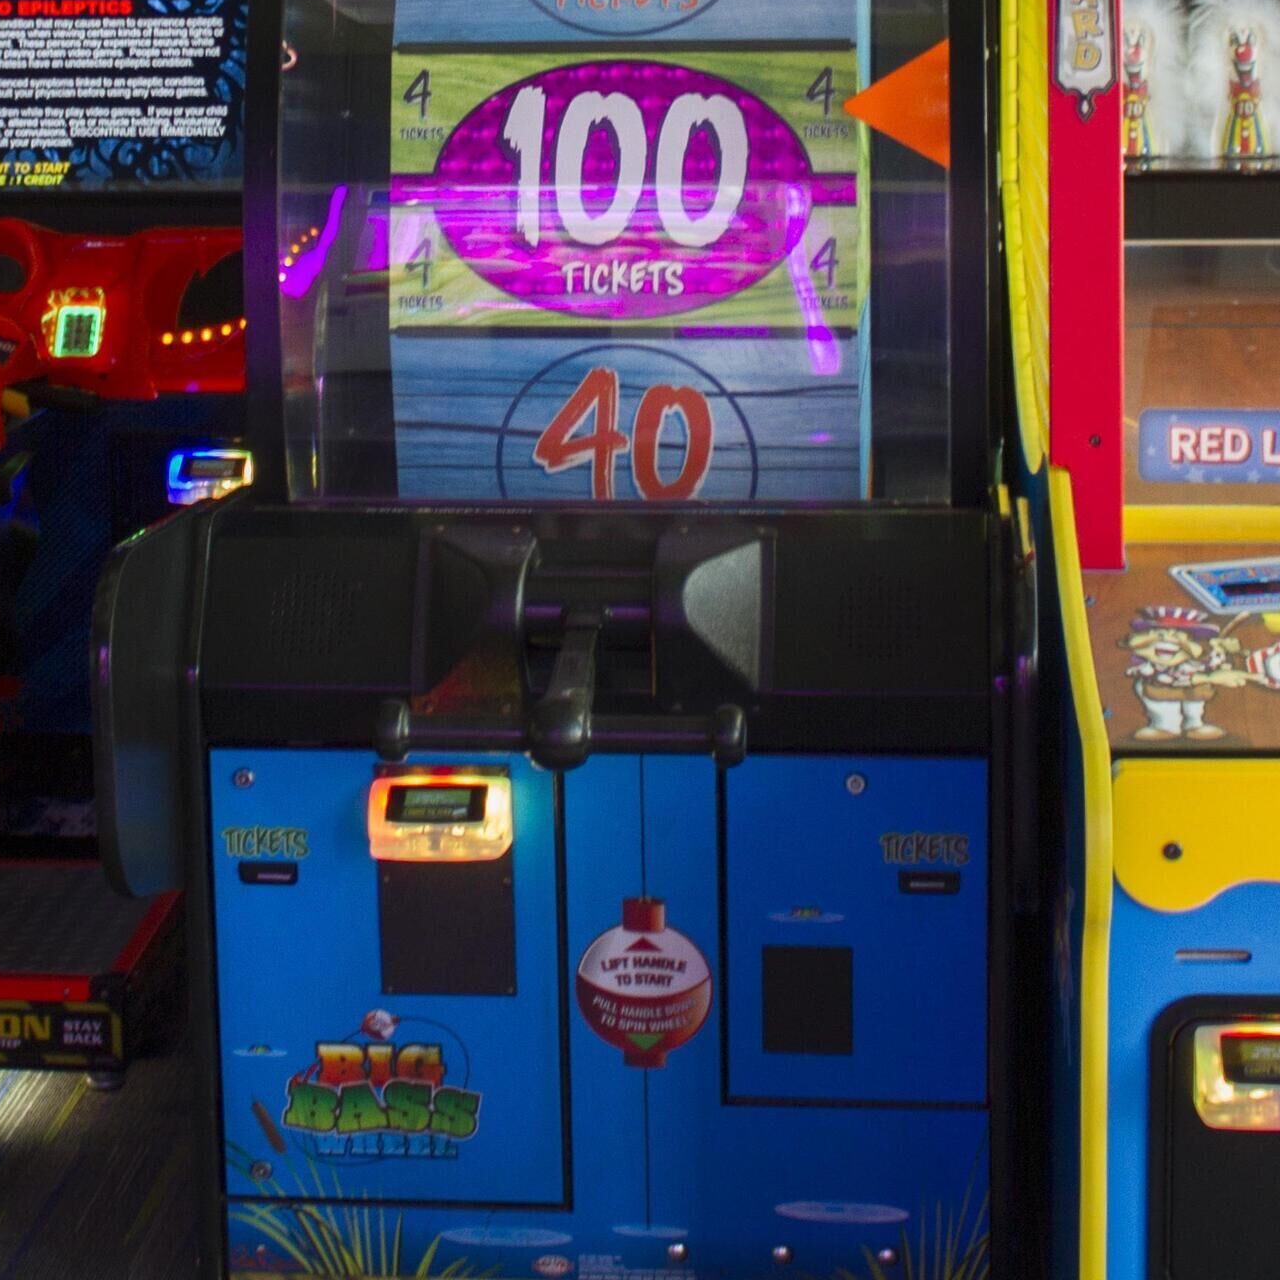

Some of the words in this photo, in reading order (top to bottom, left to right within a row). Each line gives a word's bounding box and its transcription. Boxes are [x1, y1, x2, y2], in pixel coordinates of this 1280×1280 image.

[403, 68, 432, 119] 4
[805, 66, 836, 117] 4
[399, 125, 445, 142] TICKETS
[802, 124, 849, 140] TICKETS
[14, 162, 31, 175] TO
[33, 162, 70, 174] START
[503, 85, 750, 248] 100
[404, 237, 434, 288] 4
[562, 260, 685, 297] TICKETS
[809, 237, 840, 290] 4
[398, 294, 444, 312] TICKETS
[532, 366, 714, 500] 40
[1169, 425, 1251, 465] RED
[222, 826, 310, 858] TICKETS
[879, 831, 970, 867] TICKETS
[600, 958, 629, 974] LIFT
[633, 957, 689, 976] HANDLE
[615, 974, 632, 987] TO
[635, 974, 674, 987] START
[592, 993, 617, 1014] PULL
[621, 1003, 663, 1018] HANDLE
[63, 1018, 103, 1032] STAY
[63, 1031, 103, 1046] BACK
[601, 1013, 617, 1027] TO
[618, 1017, 647, 1033] SPIN
[317, 1042, 447, 1088] BIG
[283, 1079, 482, 1140] BASS
